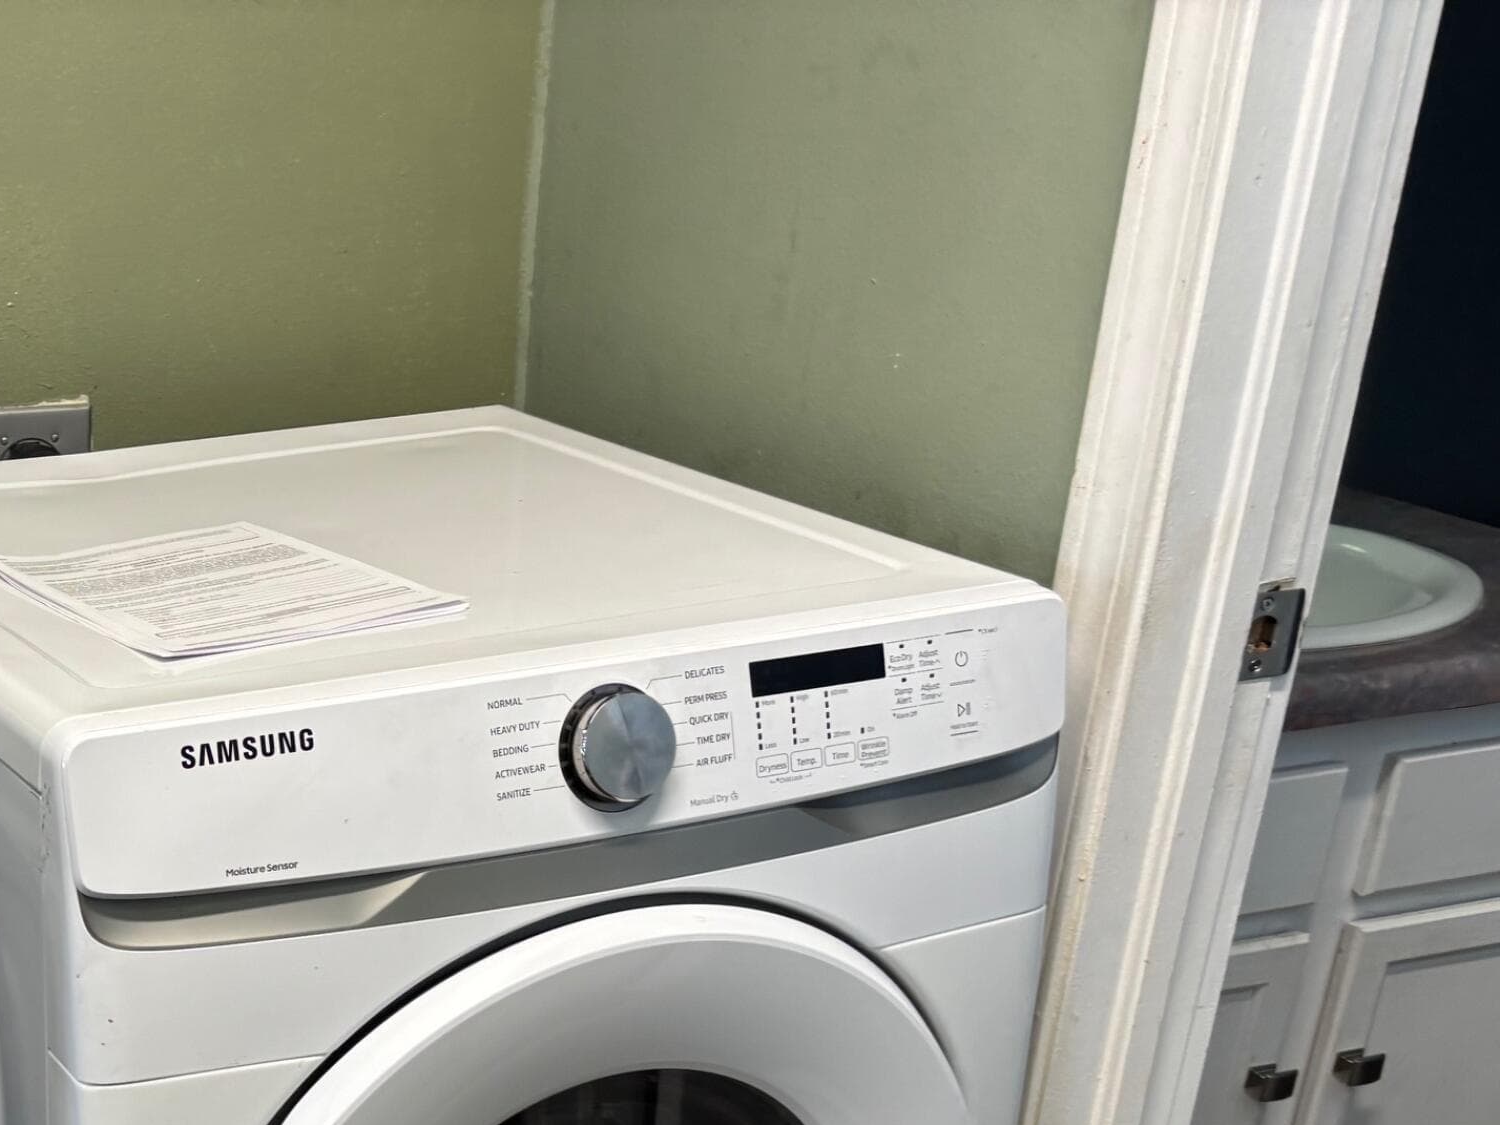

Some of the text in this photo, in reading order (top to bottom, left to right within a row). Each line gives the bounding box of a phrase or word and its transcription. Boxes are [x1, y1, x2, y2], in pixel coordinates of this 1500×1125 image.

[684, 665, 725, 680] DELICATES
[486, 697, 523, 710] NORMAL
[684, 690, 728, 705] PERM PRESS
[689, 712, 729, 726] QUICK DRY
[490, 720, 540, 736] HEAVY DUTY
[696, 732, 731, 745] TIME DRY
[180, 728, 315, 769] SAMSUNG
[492, 744, 530, 758] BEDDING
[696, 753, 733, 767] AIR FLUFF
[494, 763, 547, 780] ACTIVEWEAR
[758, 762, 788, 773] Dryness
[496, 787, 533, 801] SANITIZE
[715, 794, 729, 803] Dry
[225, 861, 298, 878] Moisture Sensor
